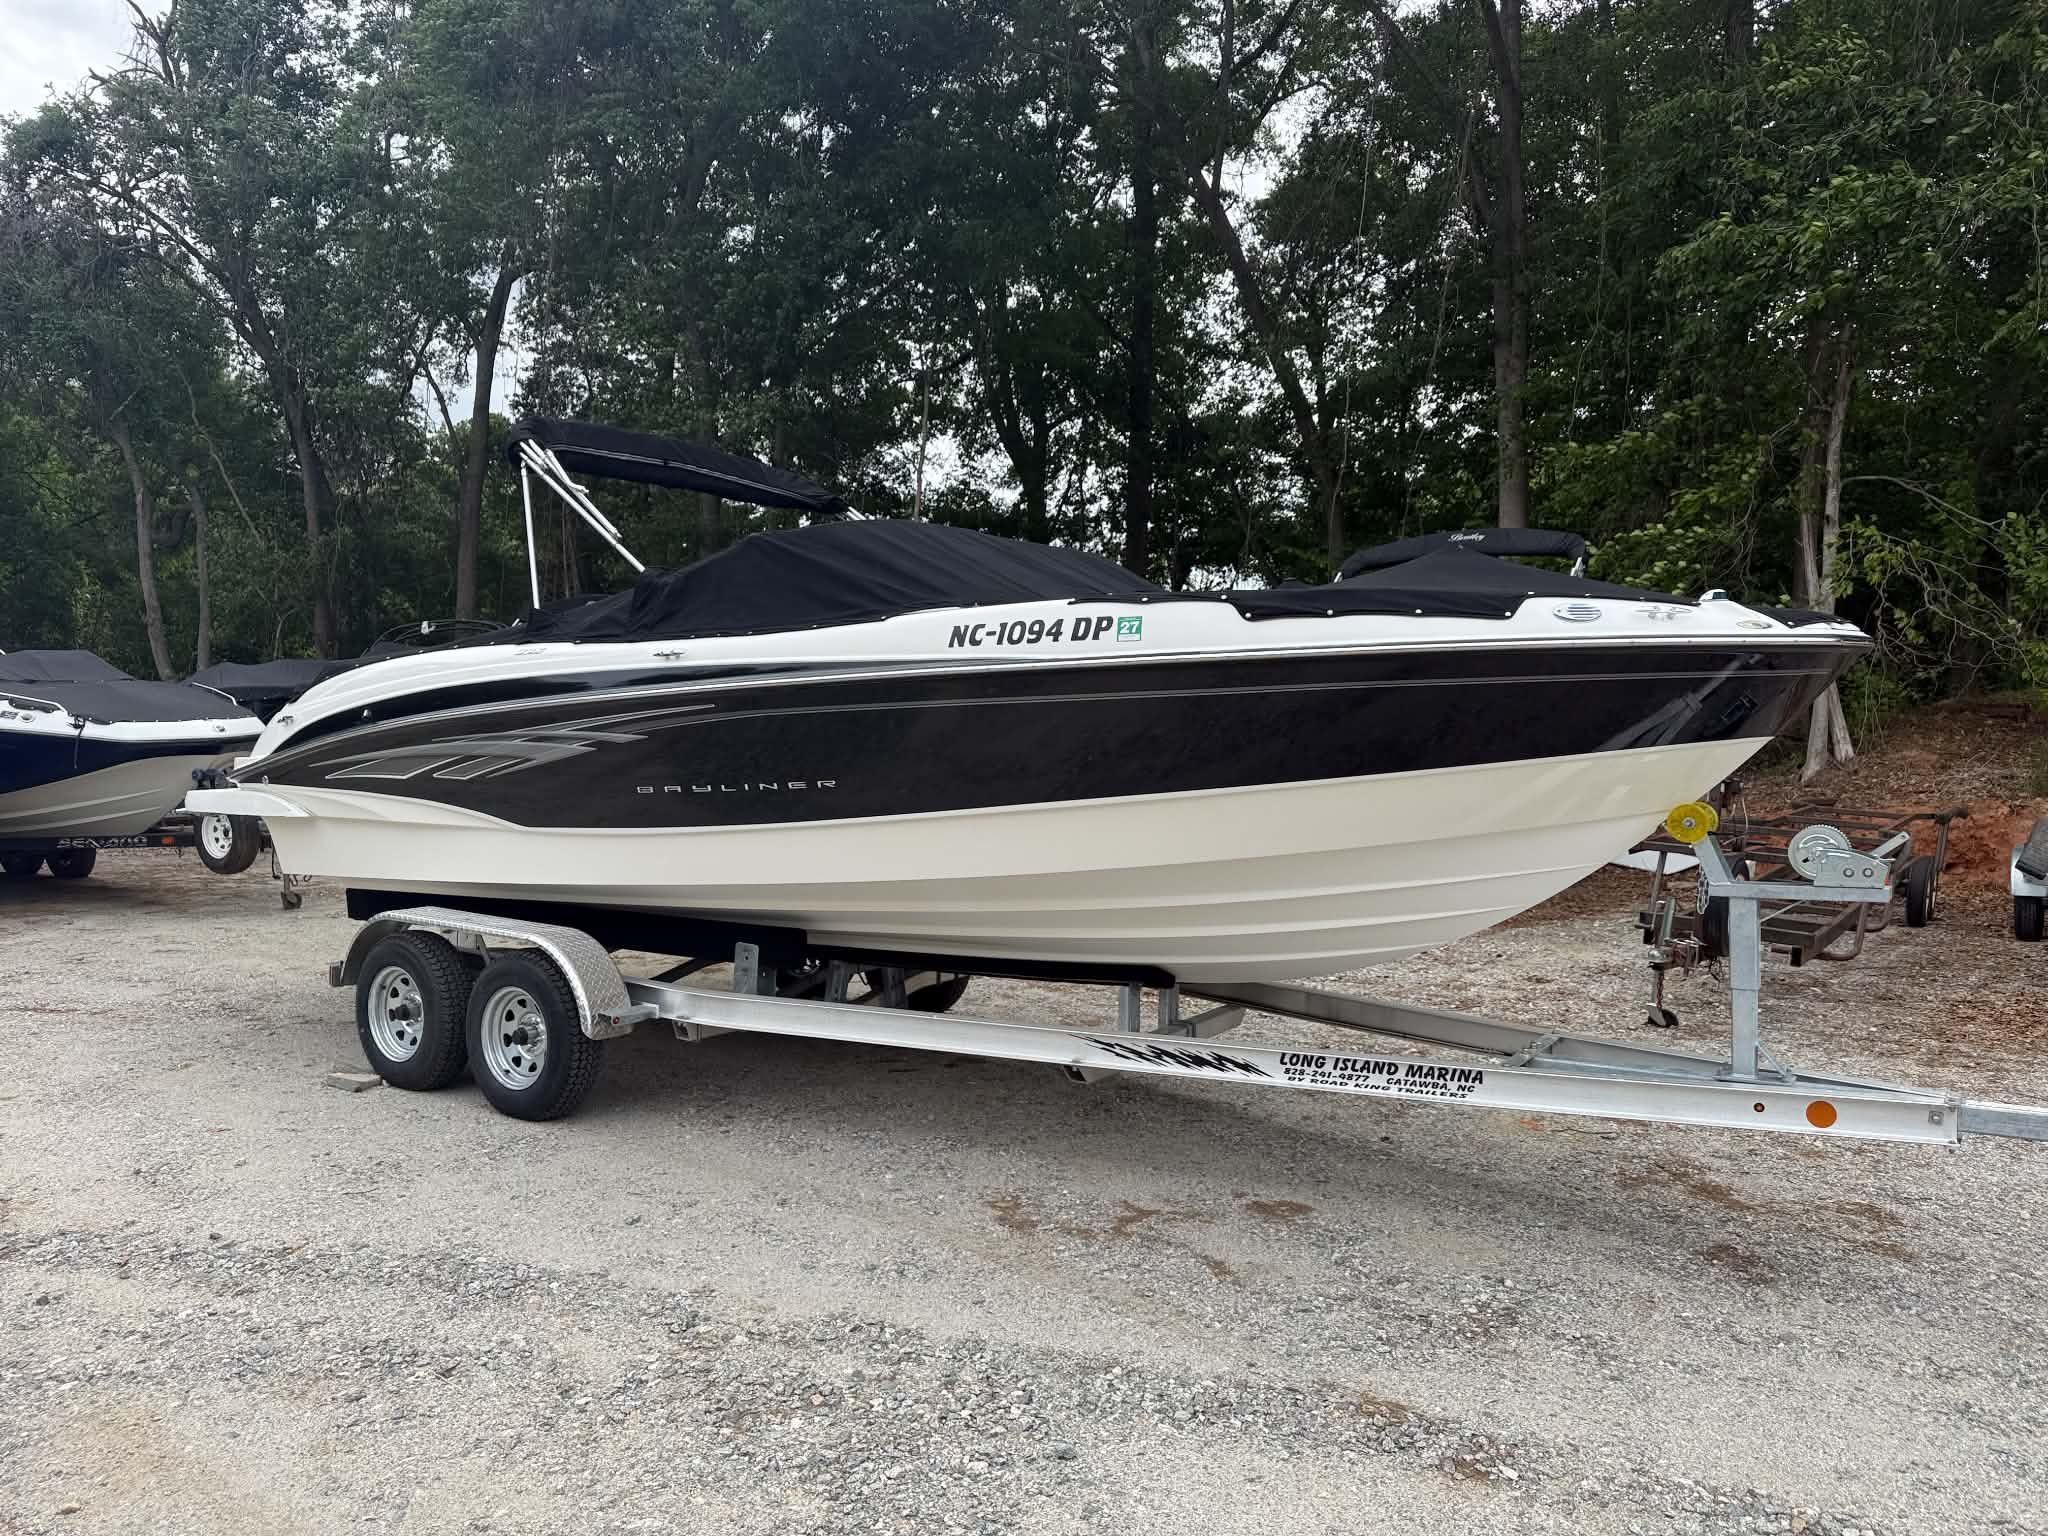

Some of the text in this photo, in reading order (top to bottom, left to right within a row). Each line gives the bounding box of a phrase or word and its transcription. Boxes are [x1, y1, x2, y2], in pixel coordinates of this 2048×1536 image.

[948, 616, 1113, 648] NC-1094 DP
[1119, 621, 1139, 634] 27
[636, 779, 836, 794] BAYLINER
[1279, 1052, 1484, 1084] LONG ISLAND MARINA
[1283, 1067, 1476, 1093] 828-241-4877 CATAWBA, NC
[1310, 1078, 1349, 1087] ROAD
[1353, 1082, 1391, 1091] KING
[1397, 1087, 1469, 1099] TRAILERS
